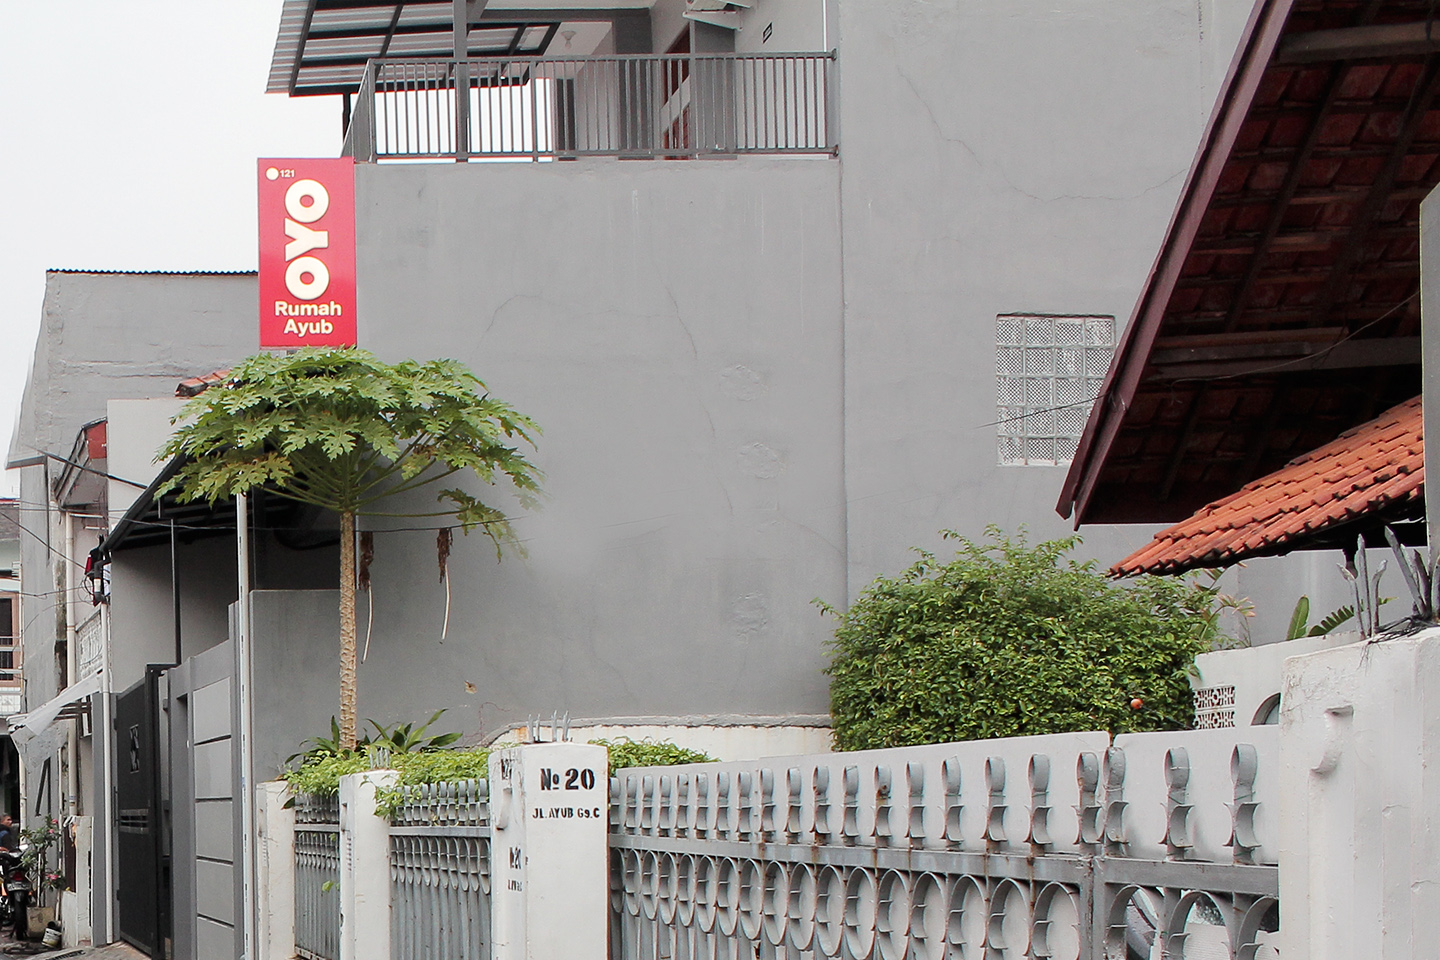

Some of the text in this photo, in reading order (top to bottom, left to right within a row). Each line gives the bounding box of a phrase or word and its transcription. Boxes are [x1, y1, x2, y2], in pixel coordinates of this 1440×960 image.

[280, 169, 295, 178] 121
[284, 179, 330, 300] OYO
[274, 300, 342, 316] Rumah
[283, 318, 334, 337] Ayub
[564, 768, 595, 790] 20
